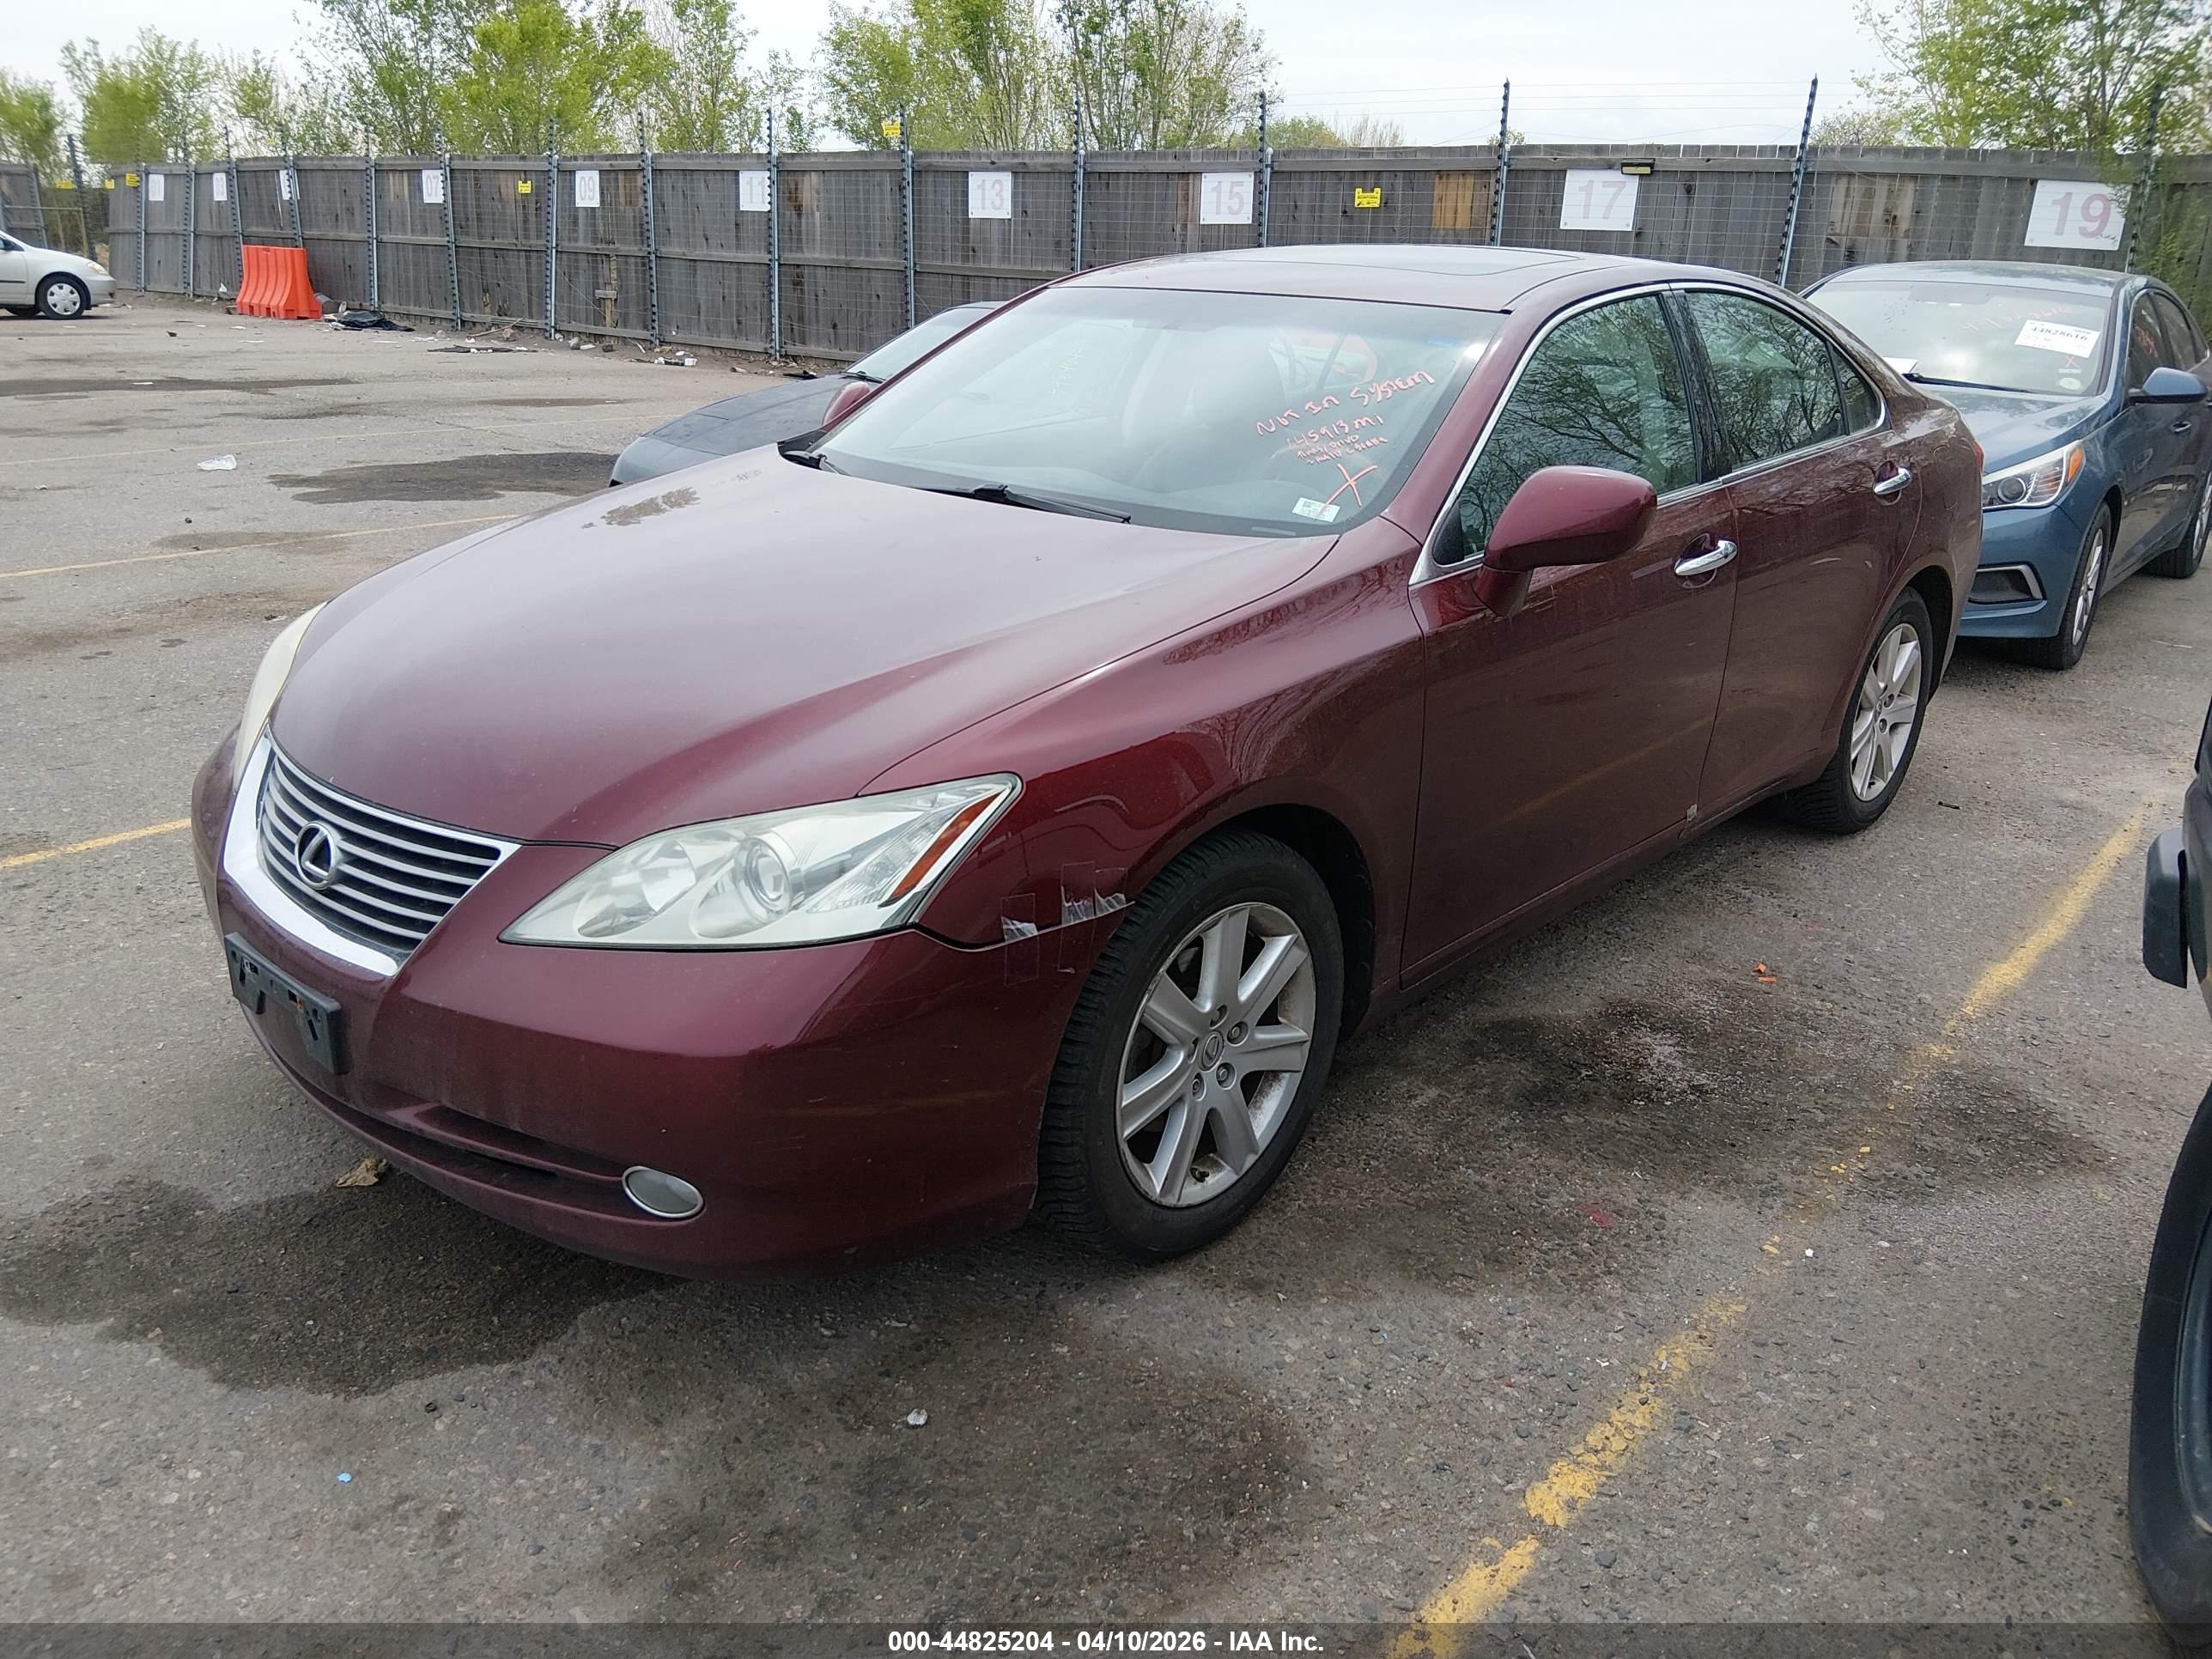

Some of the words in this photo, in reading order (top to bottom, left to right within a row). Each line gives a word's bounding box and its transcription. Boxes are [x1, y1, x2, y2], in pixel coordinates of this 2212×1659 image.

[427, 175, 440, 198] 07
[579, 175, 595, 201] 09
[745, 176, 768, 204] 11
[976, 179, 1004, 211] 13
[1210, 180, 1244, 216] 15
[1578, 179, 1627, 220] 17
[2050, 191, 2112, 239] 19
